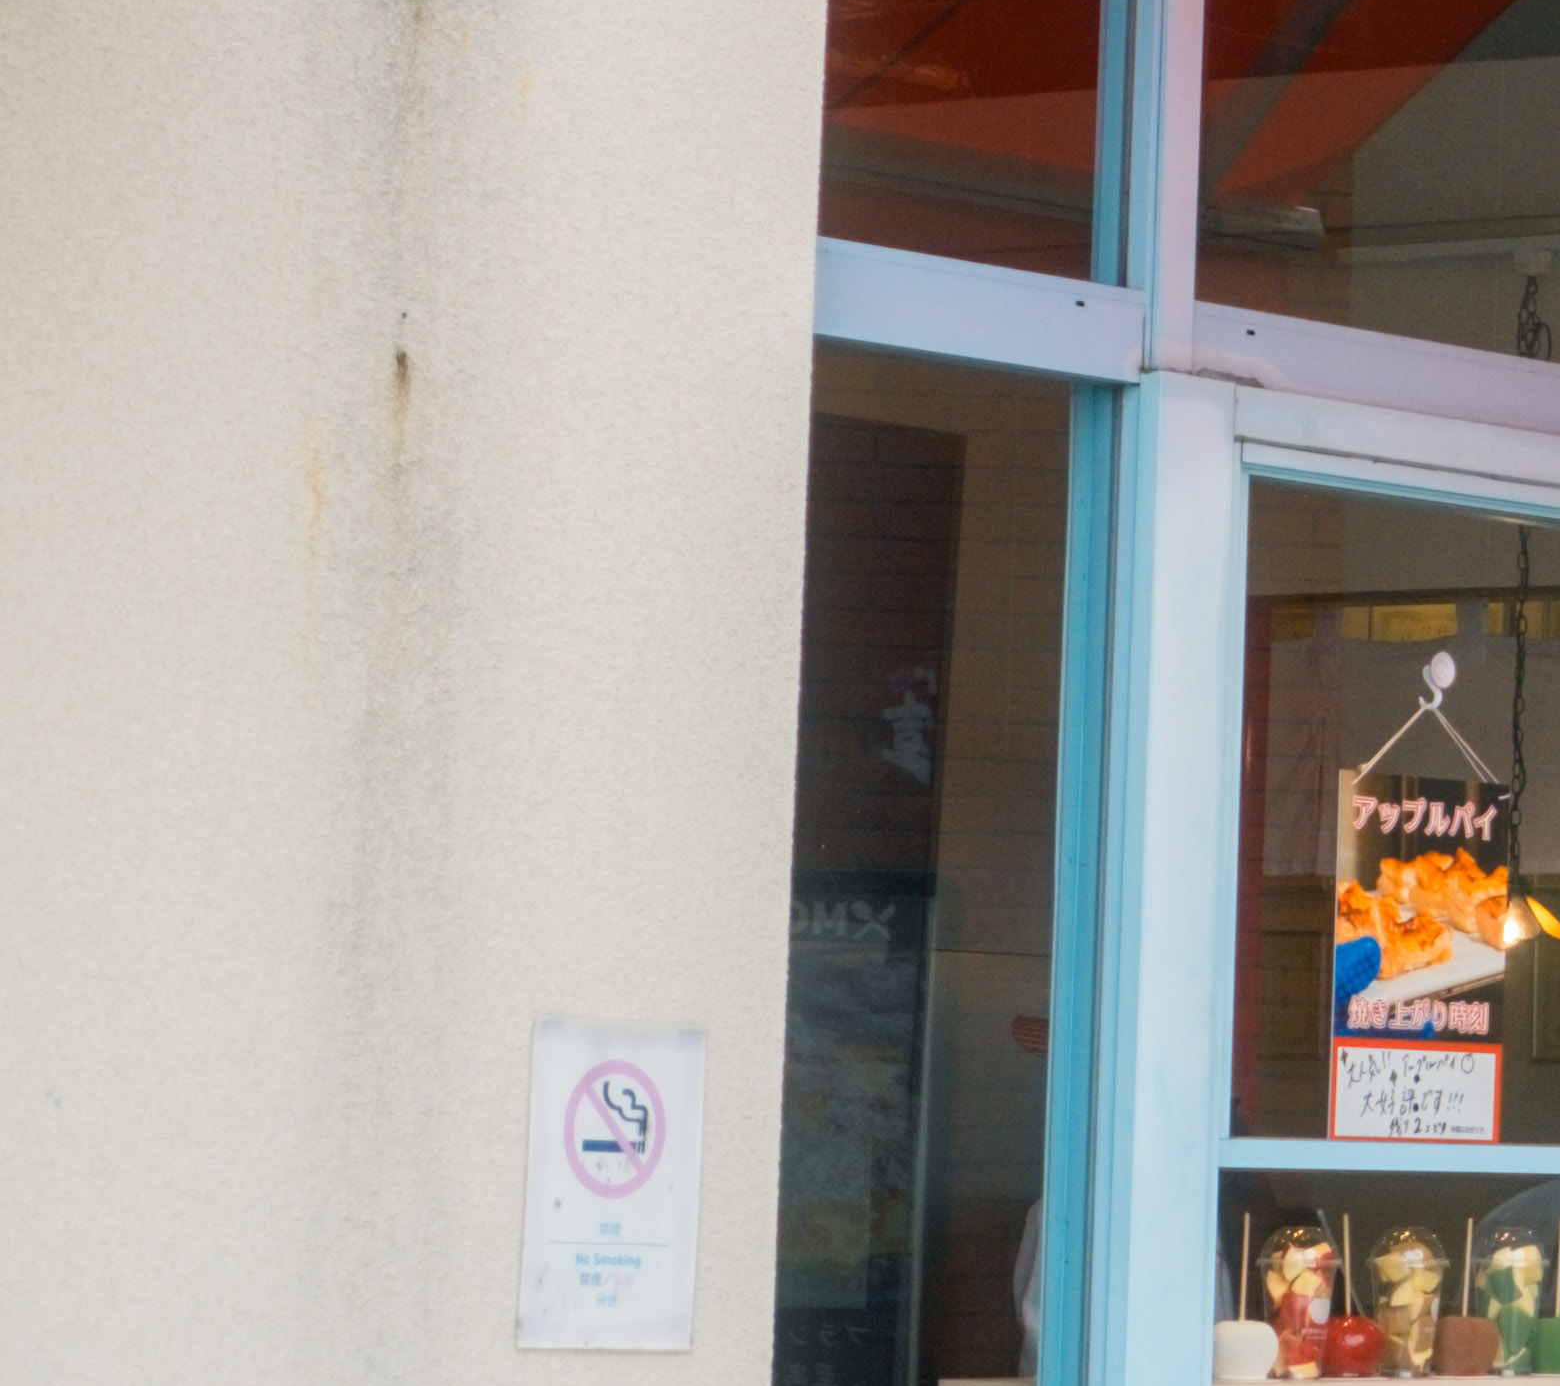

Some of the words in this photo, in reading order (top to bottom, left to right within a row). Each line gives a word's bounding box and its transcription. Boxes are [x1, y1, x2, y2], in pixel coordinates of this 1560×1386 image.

[1351, 795, 1498, 842] アップルパイ
[1347, 997, 1490, 1036] 焼き上がり時刻
